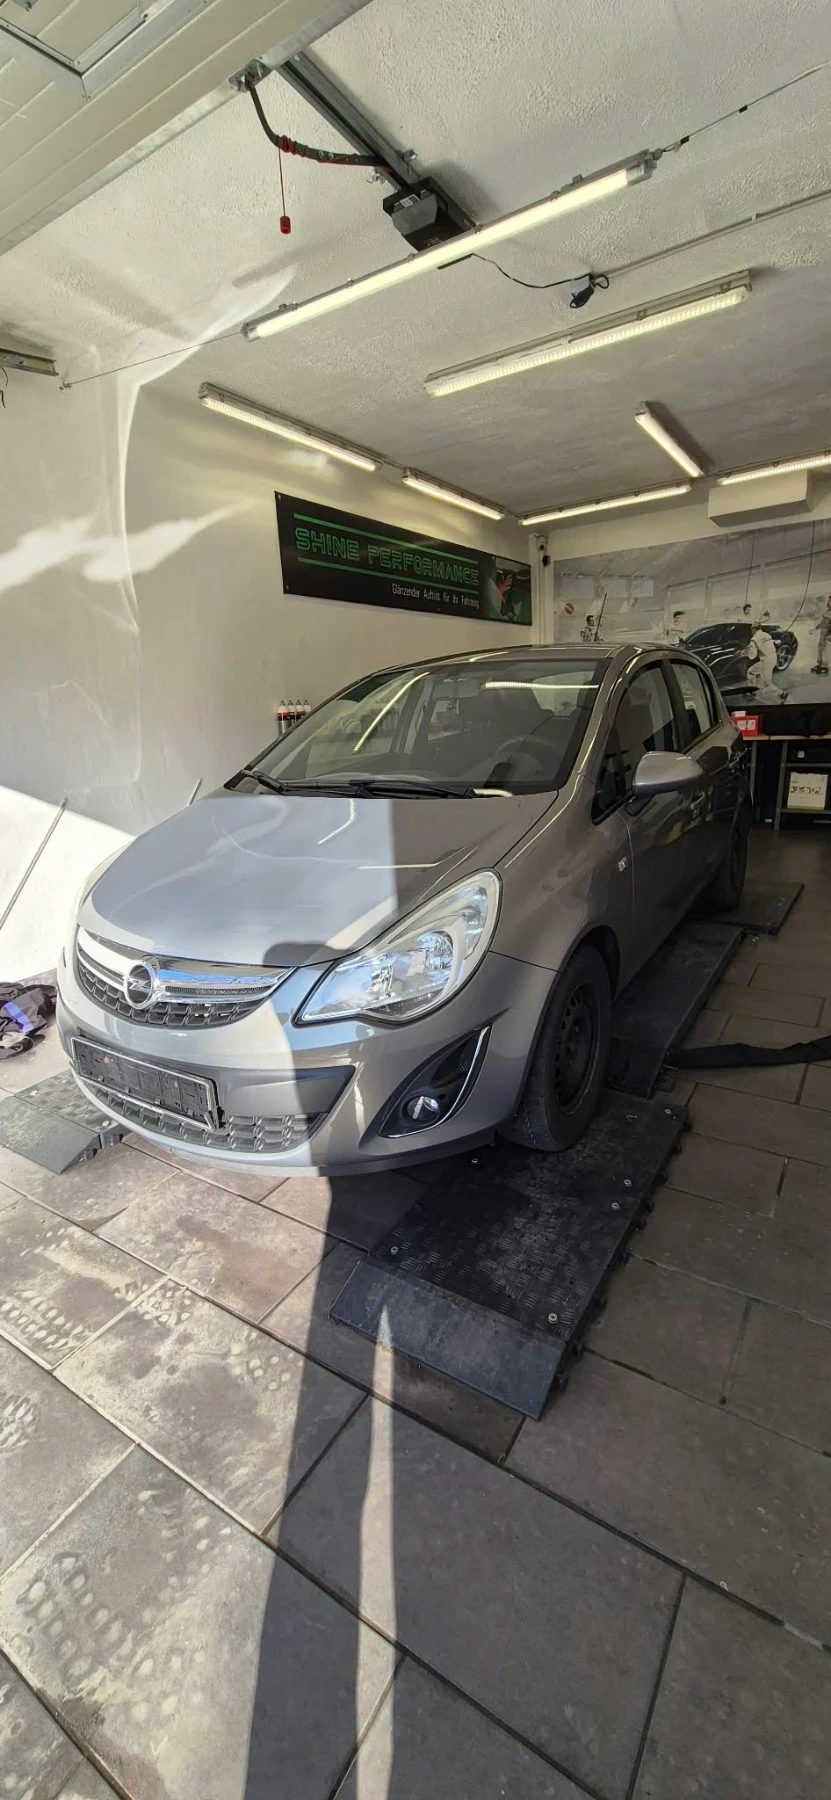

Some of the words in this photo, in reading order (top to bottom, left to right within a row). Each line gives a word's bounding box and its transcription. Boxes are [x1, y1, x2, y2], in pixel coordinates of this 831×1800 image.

[295, 527, 360, 561] SHINE
[367, 544, 479, 585] PERFORMANCE
[391, 583, 420, 598] Glänzender
